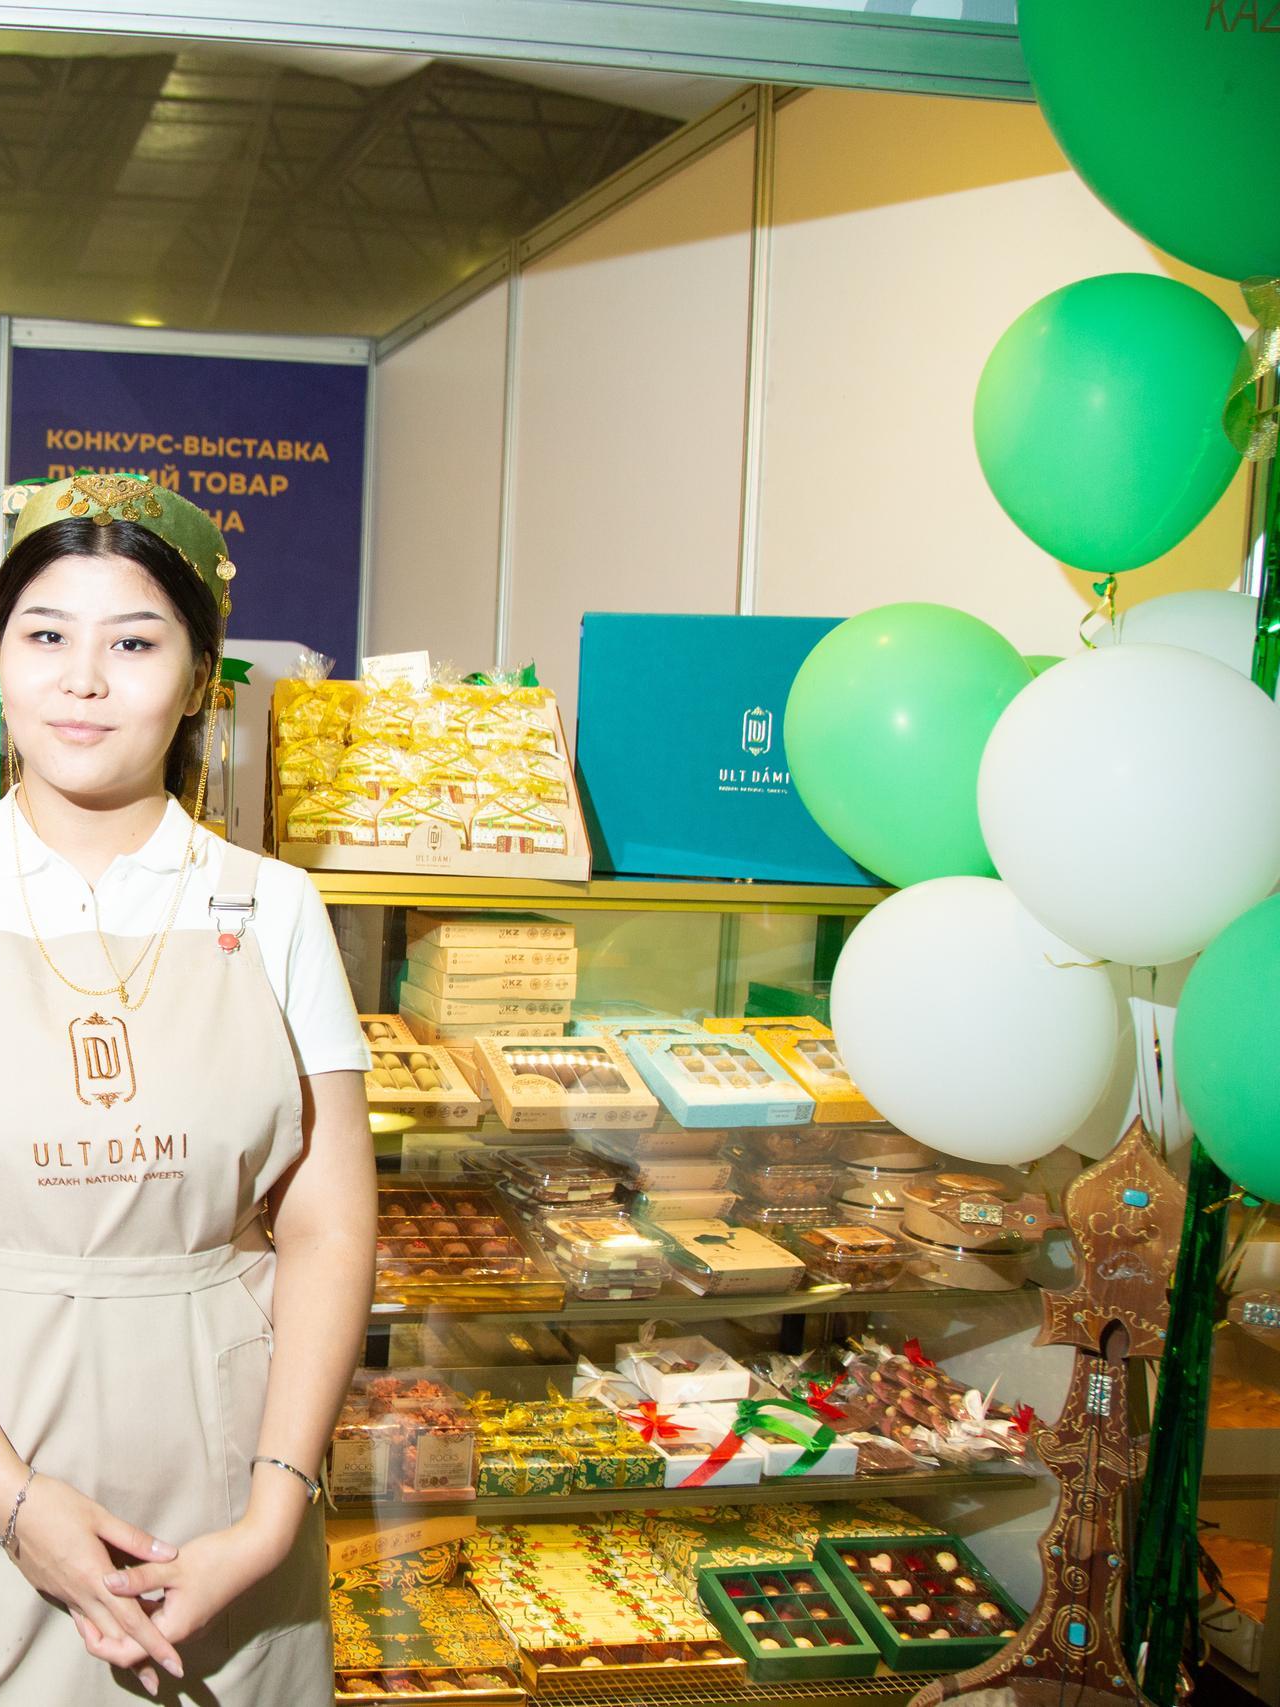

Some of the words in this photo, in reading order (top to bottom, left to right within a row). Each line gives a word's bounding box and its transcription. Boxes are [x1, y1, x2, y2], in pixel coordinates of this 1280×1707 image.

[46, 429, 330, 463] КОНКУРС-ВЫСТАВКА
[188, 470, 289, 496] ТОВАР
[719, 768, 747, 782] ULT
[751, 766, 791, 784] DÁMI
[32, 1141, 91, 1167] ULT
[107, 1124, 188, 1165] DÁMI
[37, 1177, 81, 1187] KAZAKH
[85, 1174, 139, 1186] NATIONAL
[143, 1170, 184, 1182] SWEETS
[344, 1463, 375, 1472] ROCKS
